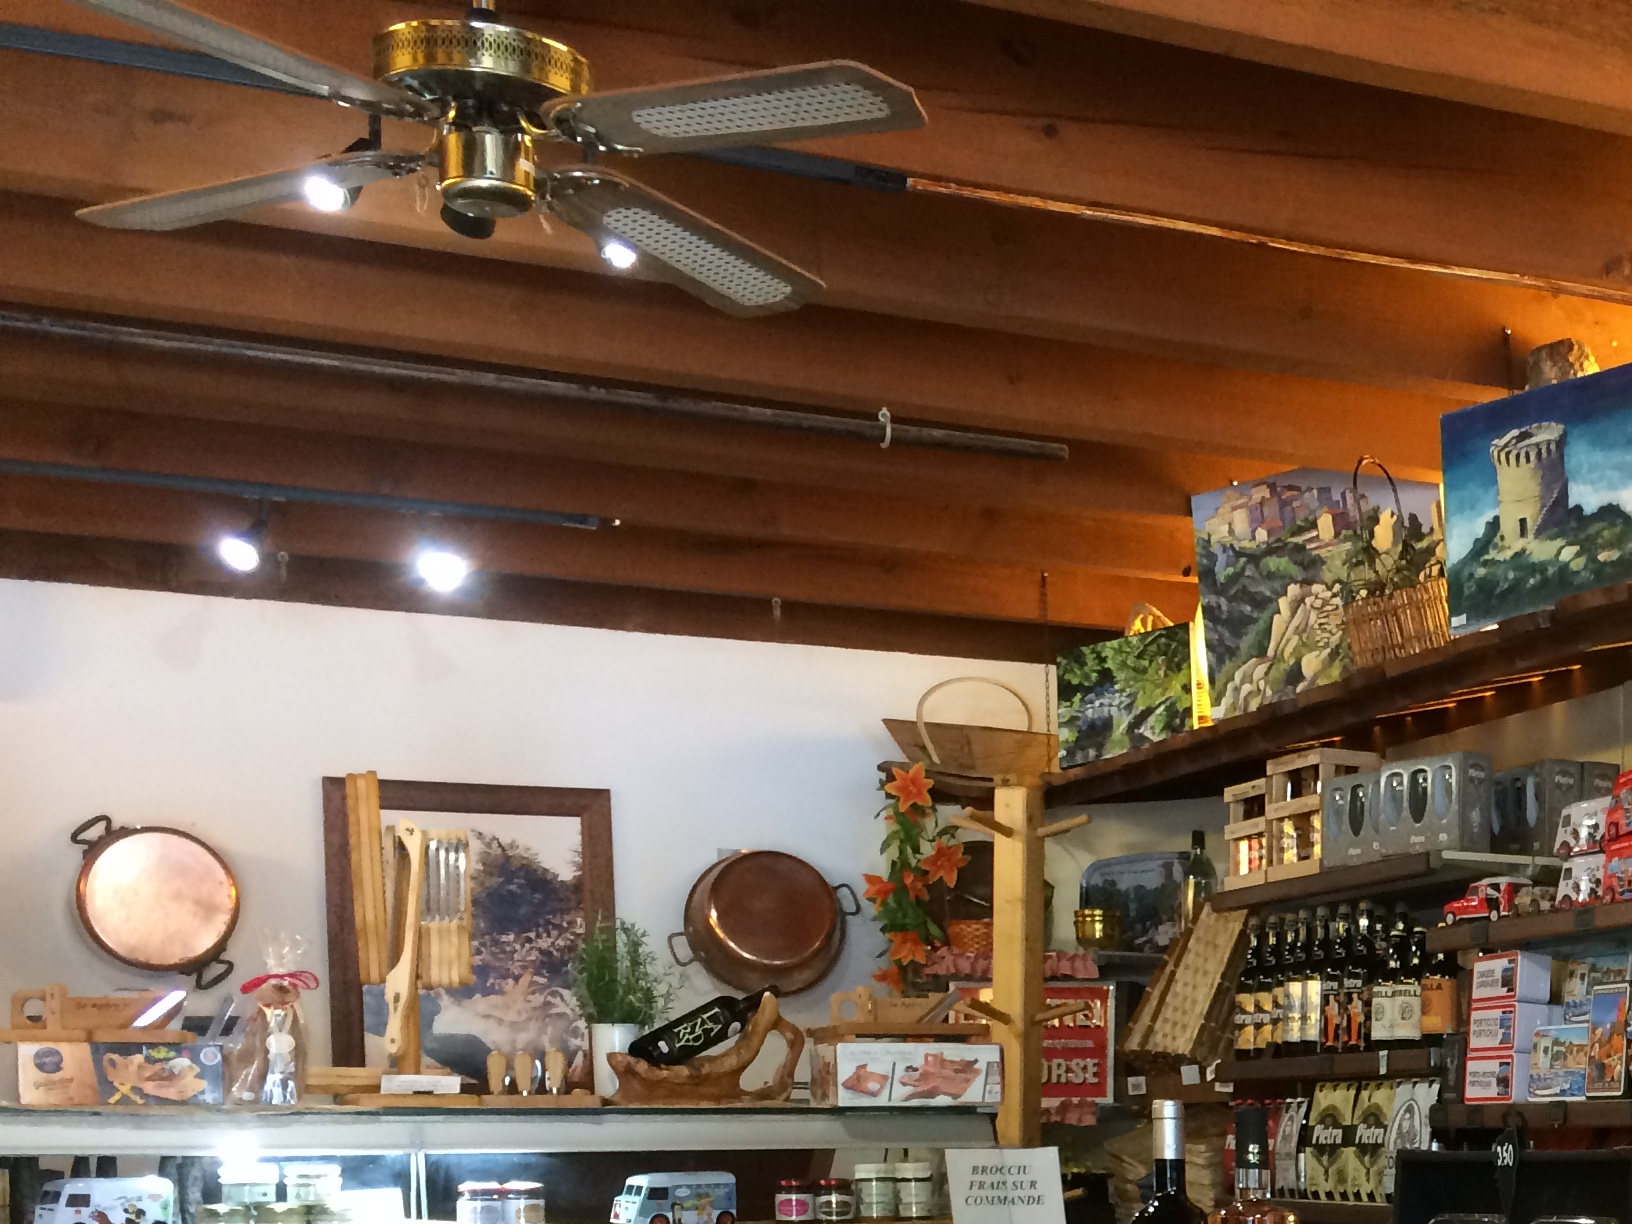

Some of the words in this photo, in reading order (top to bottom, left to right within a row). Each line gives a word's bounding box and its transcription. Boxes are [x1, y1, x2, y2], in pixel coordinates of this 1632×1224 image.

[1312, 1125, 1343, 1145] Pietra
[1355, 1123, 1385, 1144] Pietra
[971, 1164, 1032, 1176] BROCCIU
[969, 1180, 1008, 1191] FRAIS
[1011, 1179, 1038, 1191] SUR
[965, 1194, 1045, 1207] COMMANDE
